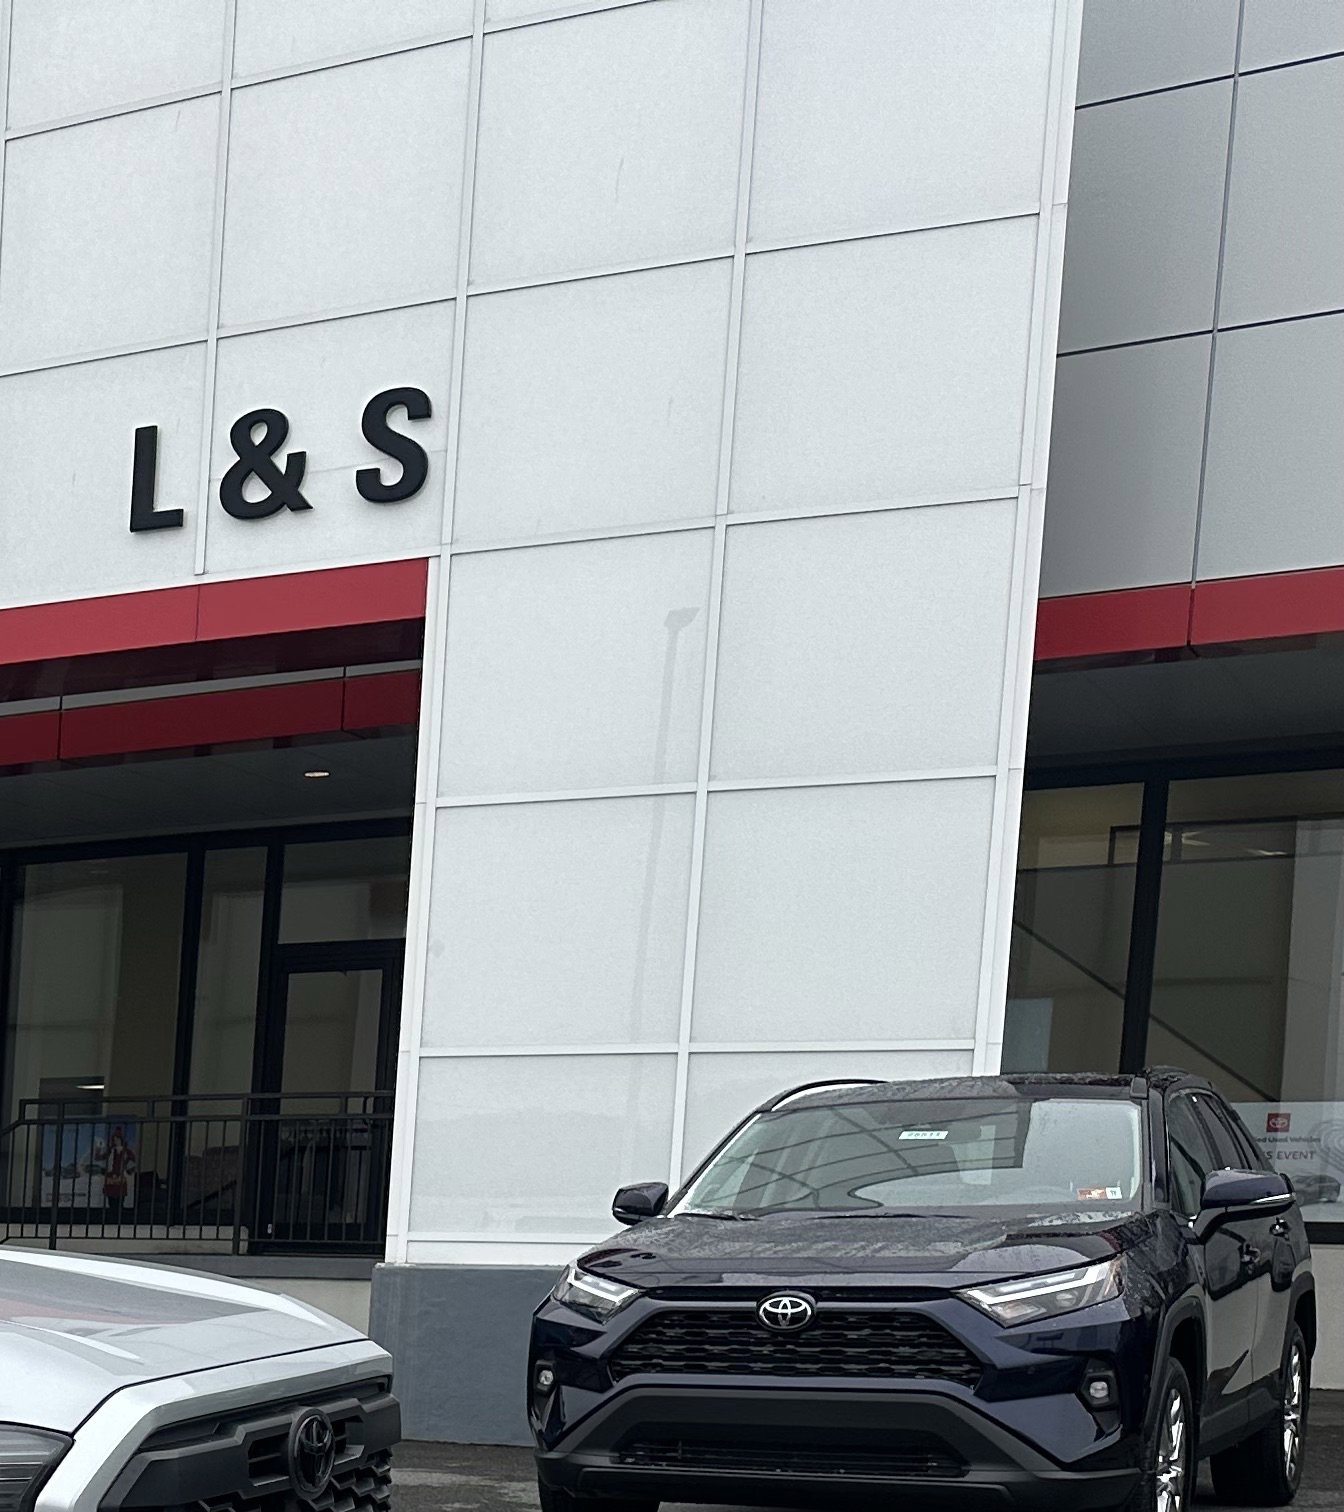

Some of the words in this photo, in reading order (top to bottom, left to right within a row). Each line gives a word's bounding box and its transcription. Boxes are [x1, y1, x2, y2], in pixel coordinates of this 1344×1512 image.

[130, 425, 184, 532] L
[219, 408, 313, 520] &
[356, 386, 432, 503] S
[1277, 1151, 1315, 1160] EVENT
